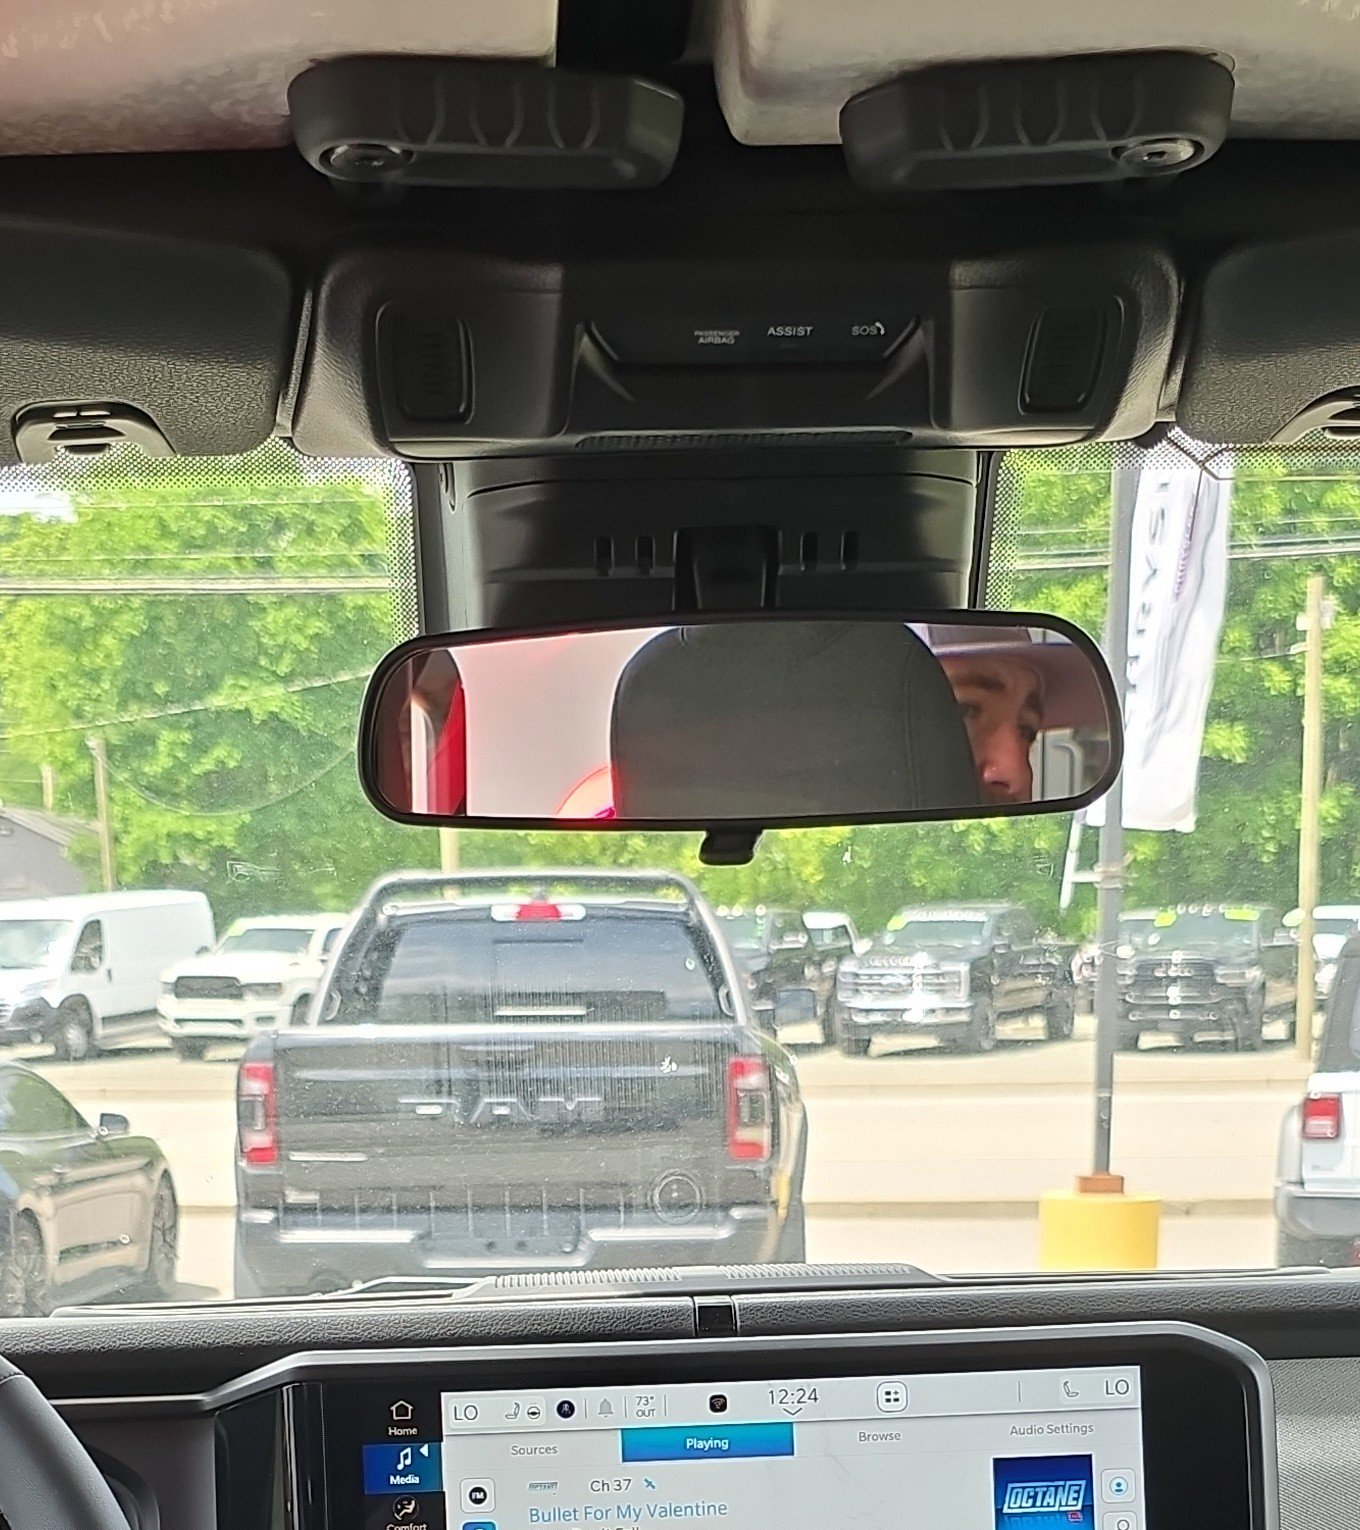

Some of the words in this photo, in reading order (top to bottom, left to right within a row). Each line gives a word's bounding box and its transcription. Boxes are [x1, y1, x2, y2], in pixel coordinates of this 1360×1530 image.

[767, 326, 813, 336] ASSIST
[852, 325, 877, 335] SOS
[1105, 1379, 1130, 1396] LO
[768, 1388, 819, 1405] 12:24
[454, 1405, 478, 1421] LO
[636, 1408, 656, 1417] OUT
[388, 1427, 418, 1436] Home
[1009, 1423, 1044, 1436] Audio
[1046, 1420, 1094, 1436] Settings
[858, 1430, 901, 1443] Browse
[511, 1445, 558, 1456] Sources
[685, 1437, 729, 1451] Playing
[390, 1475, 419, 1485] Media
[590, 1480, 610, 1492] Ch
[613, 1479, 632, 1491] 37
[1009, 1486, 1080, 1508] OCTANE
[529, 1507, 579, 1523] Bullet
[584, 1506, 611, 1520] For
[616, 1505, 642, 1522] My
[646, 1501, 728, 1518] Valentine
